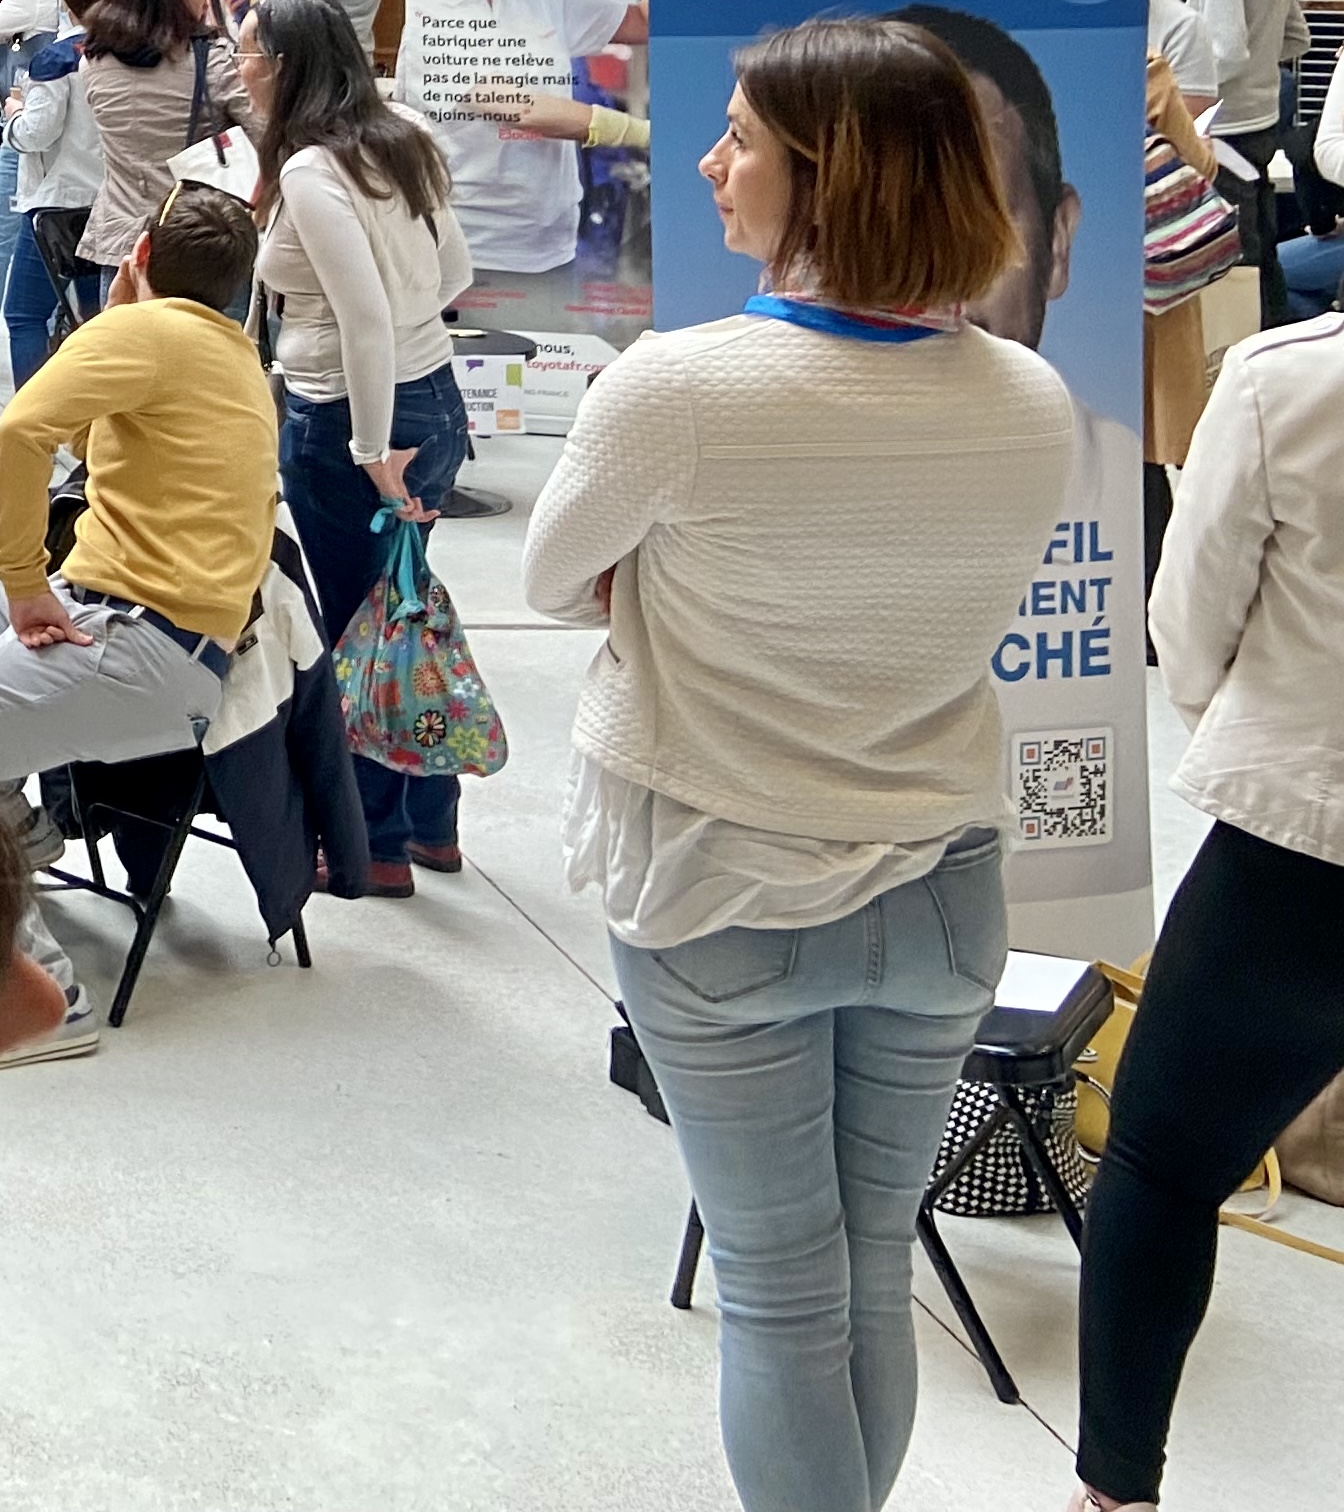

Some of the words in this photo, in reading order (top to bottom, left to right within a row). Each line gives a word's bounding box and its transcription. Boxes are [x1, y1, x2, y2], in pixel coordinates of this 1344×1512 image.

[422, 16, 465, 29] Parce
[468, 19, 498, 32] que
[422, 35, 494, 50] fabriquer
[497, 37, 527, 48] une
[422, 54, 479, 66] voiture
[482, 56, 501, 66] ne
[505, 52, 555, 67] relève
[423, 73, 449, 86] pas
[452, 72, 471, 85] de
[474, 72, 487, 85] la
[491, 72, 539, 88] magie
[542, 72, 579, 86] mais
[423, 90, 441, 102] de
[444, 92, 472, 103] nos
[475, 91, 535, 106] talents,
[462, 389, 498, 399] TENANCE
[1018, 577, 1113, 616] ENT
[991, 615, 1112, 682] CHÉ
